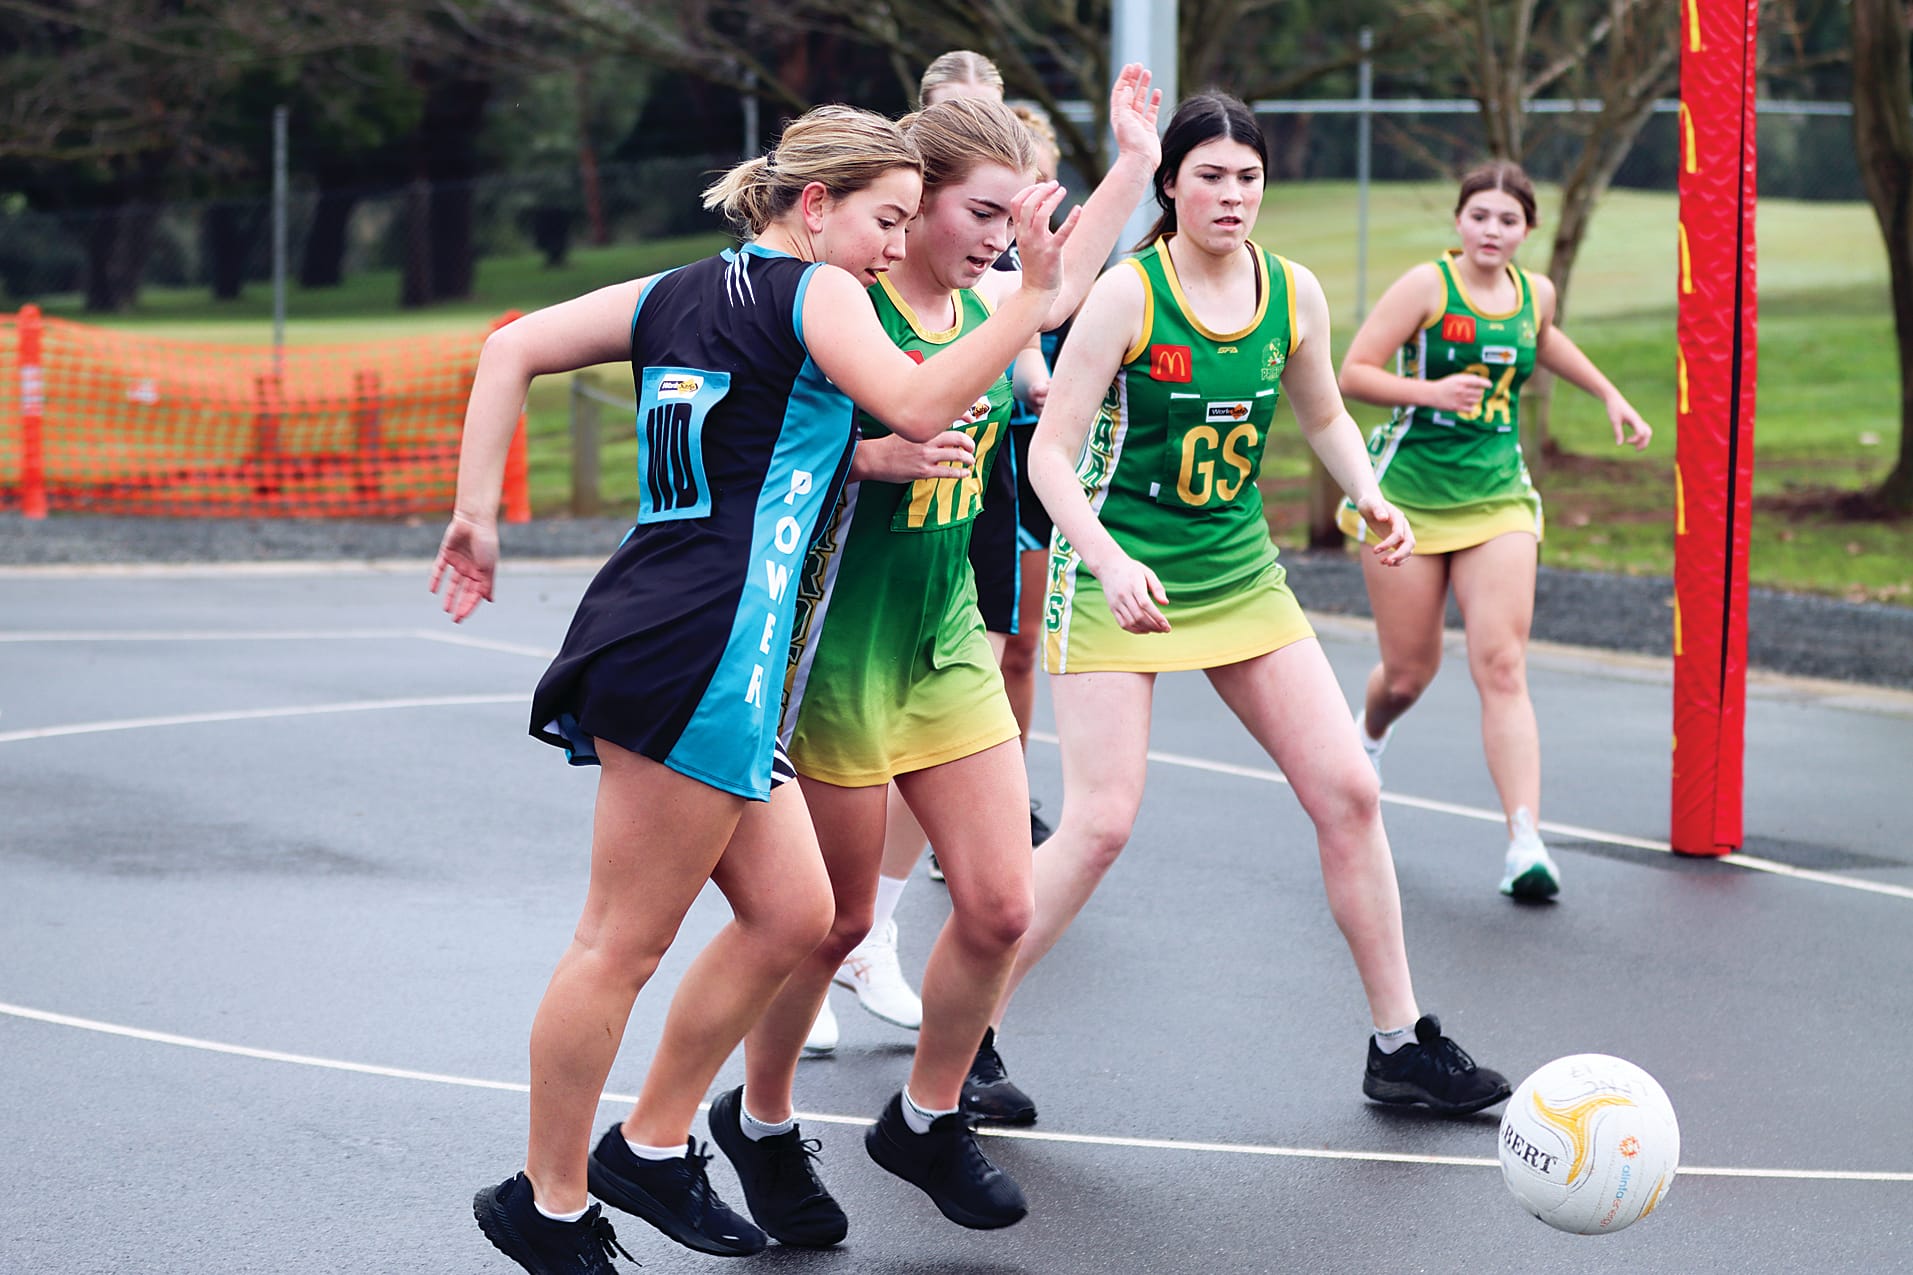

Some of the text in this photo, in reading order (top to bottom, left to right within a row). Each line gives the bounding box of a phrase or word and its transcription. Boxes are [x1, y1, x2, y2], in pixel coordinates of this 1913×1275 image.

[646, 402, 699, 513] WD
[1176, 422, 1258, 506] GS
[744, 469, 813, 709] POWER
